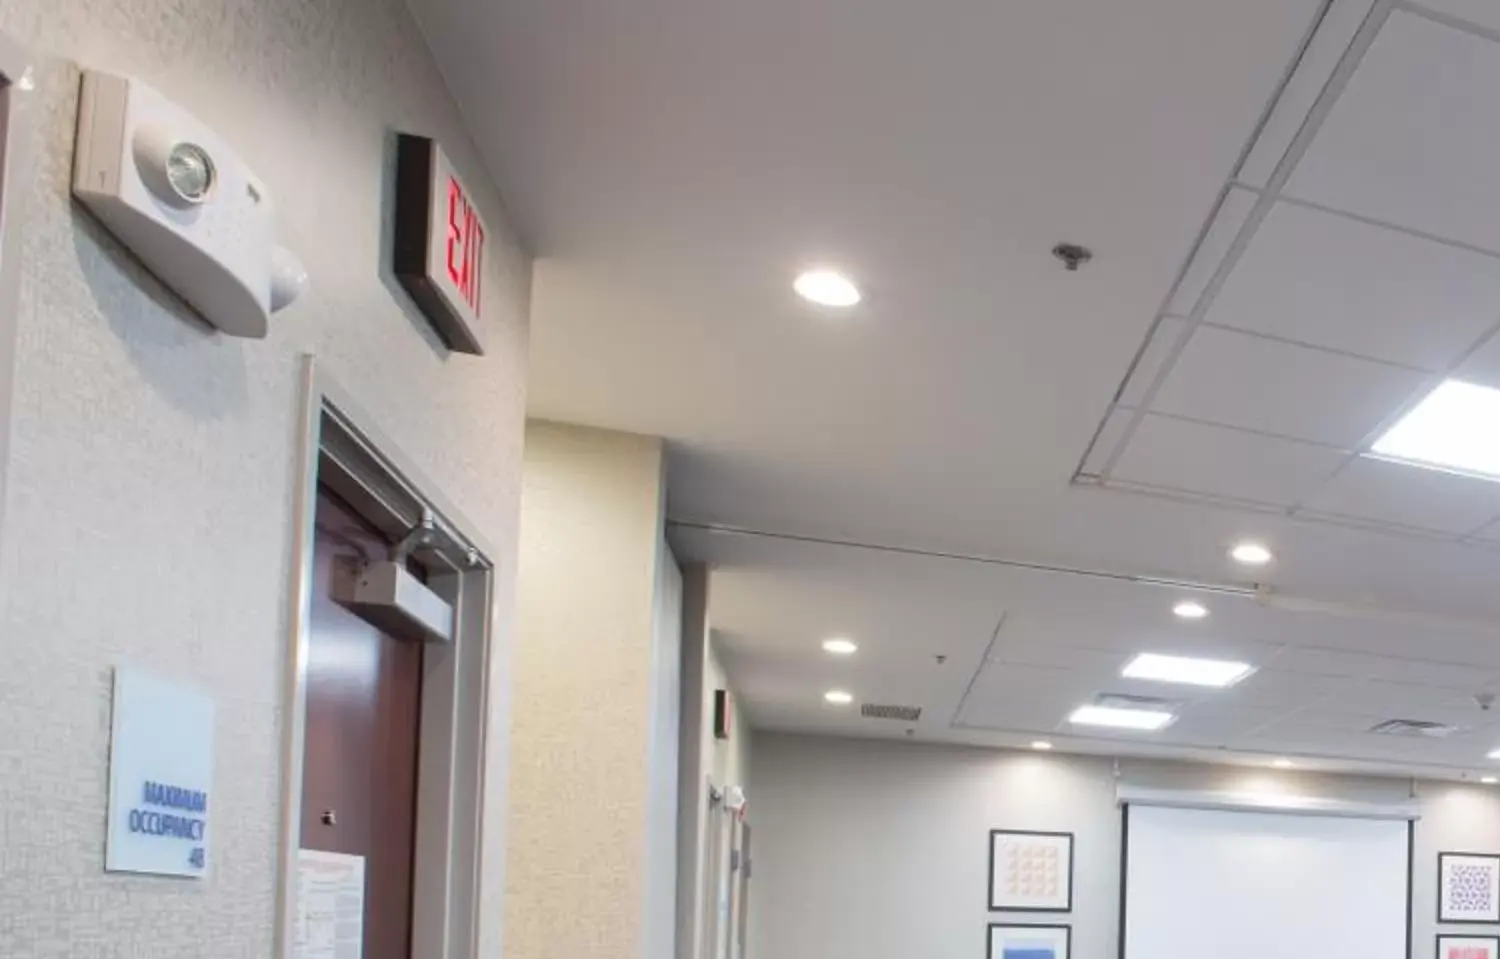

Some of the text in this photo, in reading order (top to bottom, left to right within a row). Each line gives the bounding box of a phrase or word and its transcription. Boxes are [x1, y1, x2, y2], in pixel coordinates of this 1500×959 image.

[447, 174, 484, 320] EXIT
[143, 780, 207, 813] MAXIMUM
[129, 808, 205, 841] OCCUPANCY
